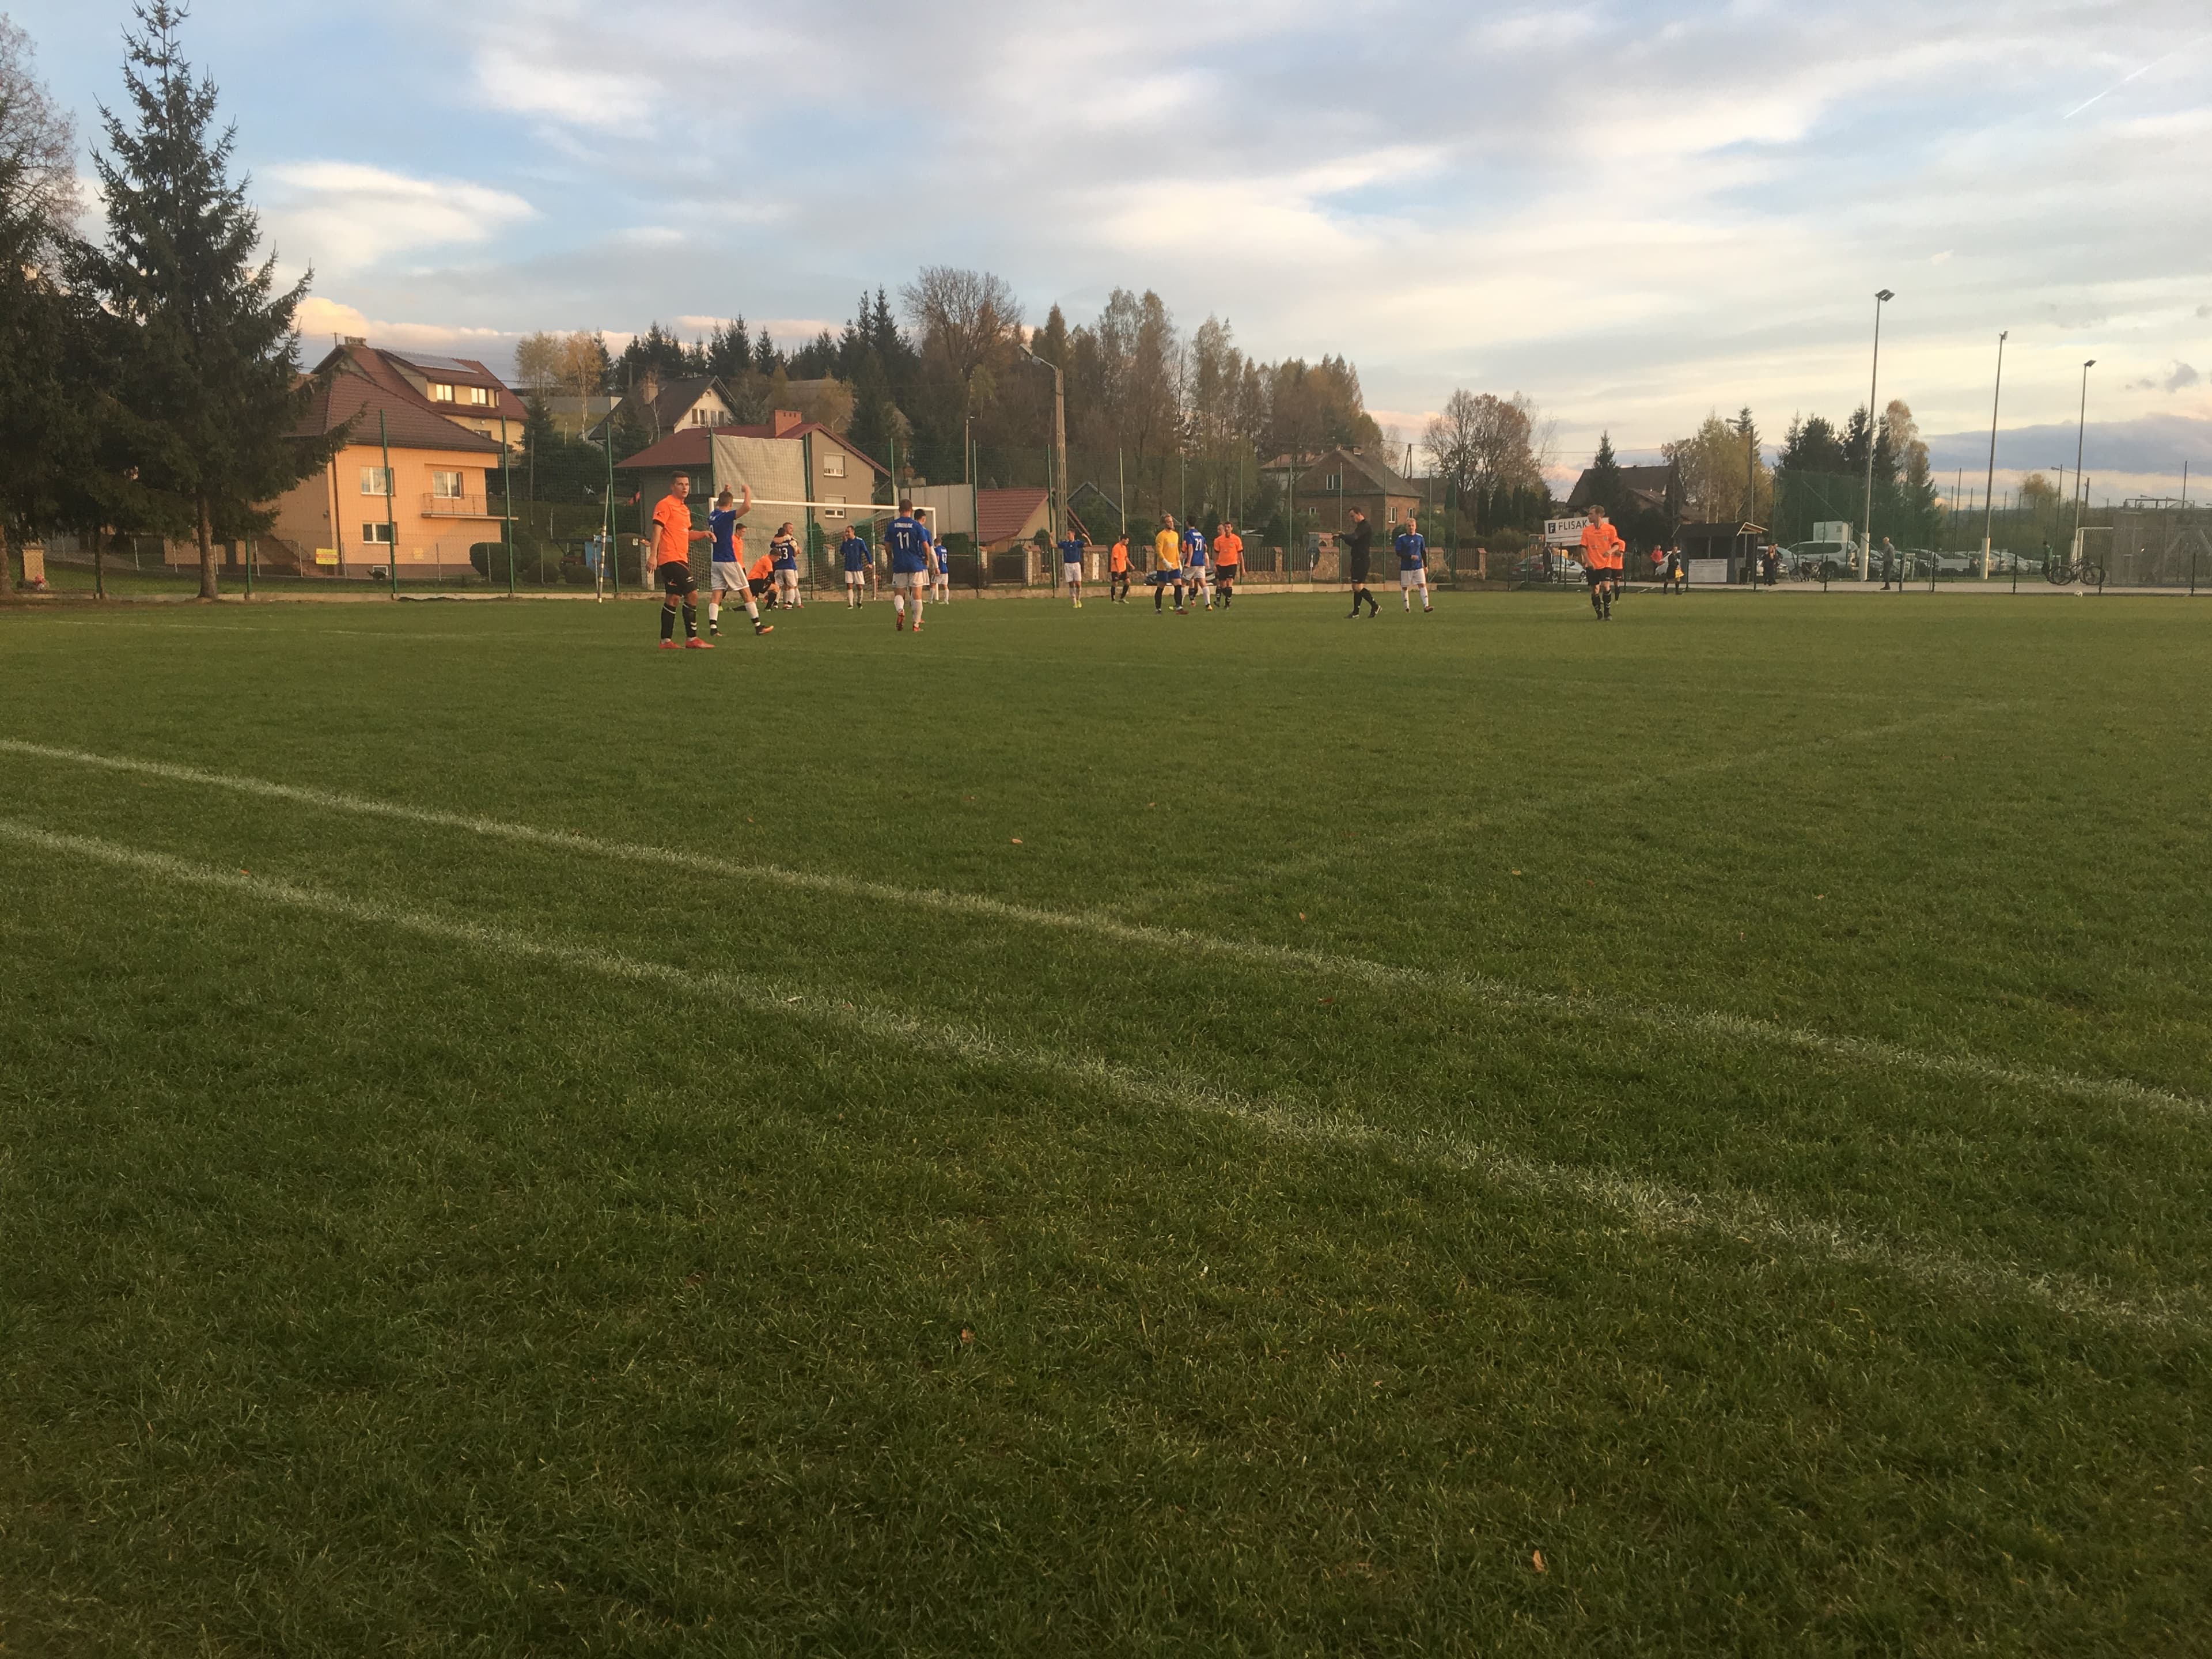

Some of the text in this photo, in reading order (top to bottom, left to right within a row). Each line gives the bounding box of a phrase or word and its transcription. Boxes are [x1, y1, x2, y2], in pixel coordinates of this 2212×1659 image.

[1558, 520, 1588, 530] FLISAK
[896, 532, 909, 548] 11
[1195, 538, 1202, 551] 21
